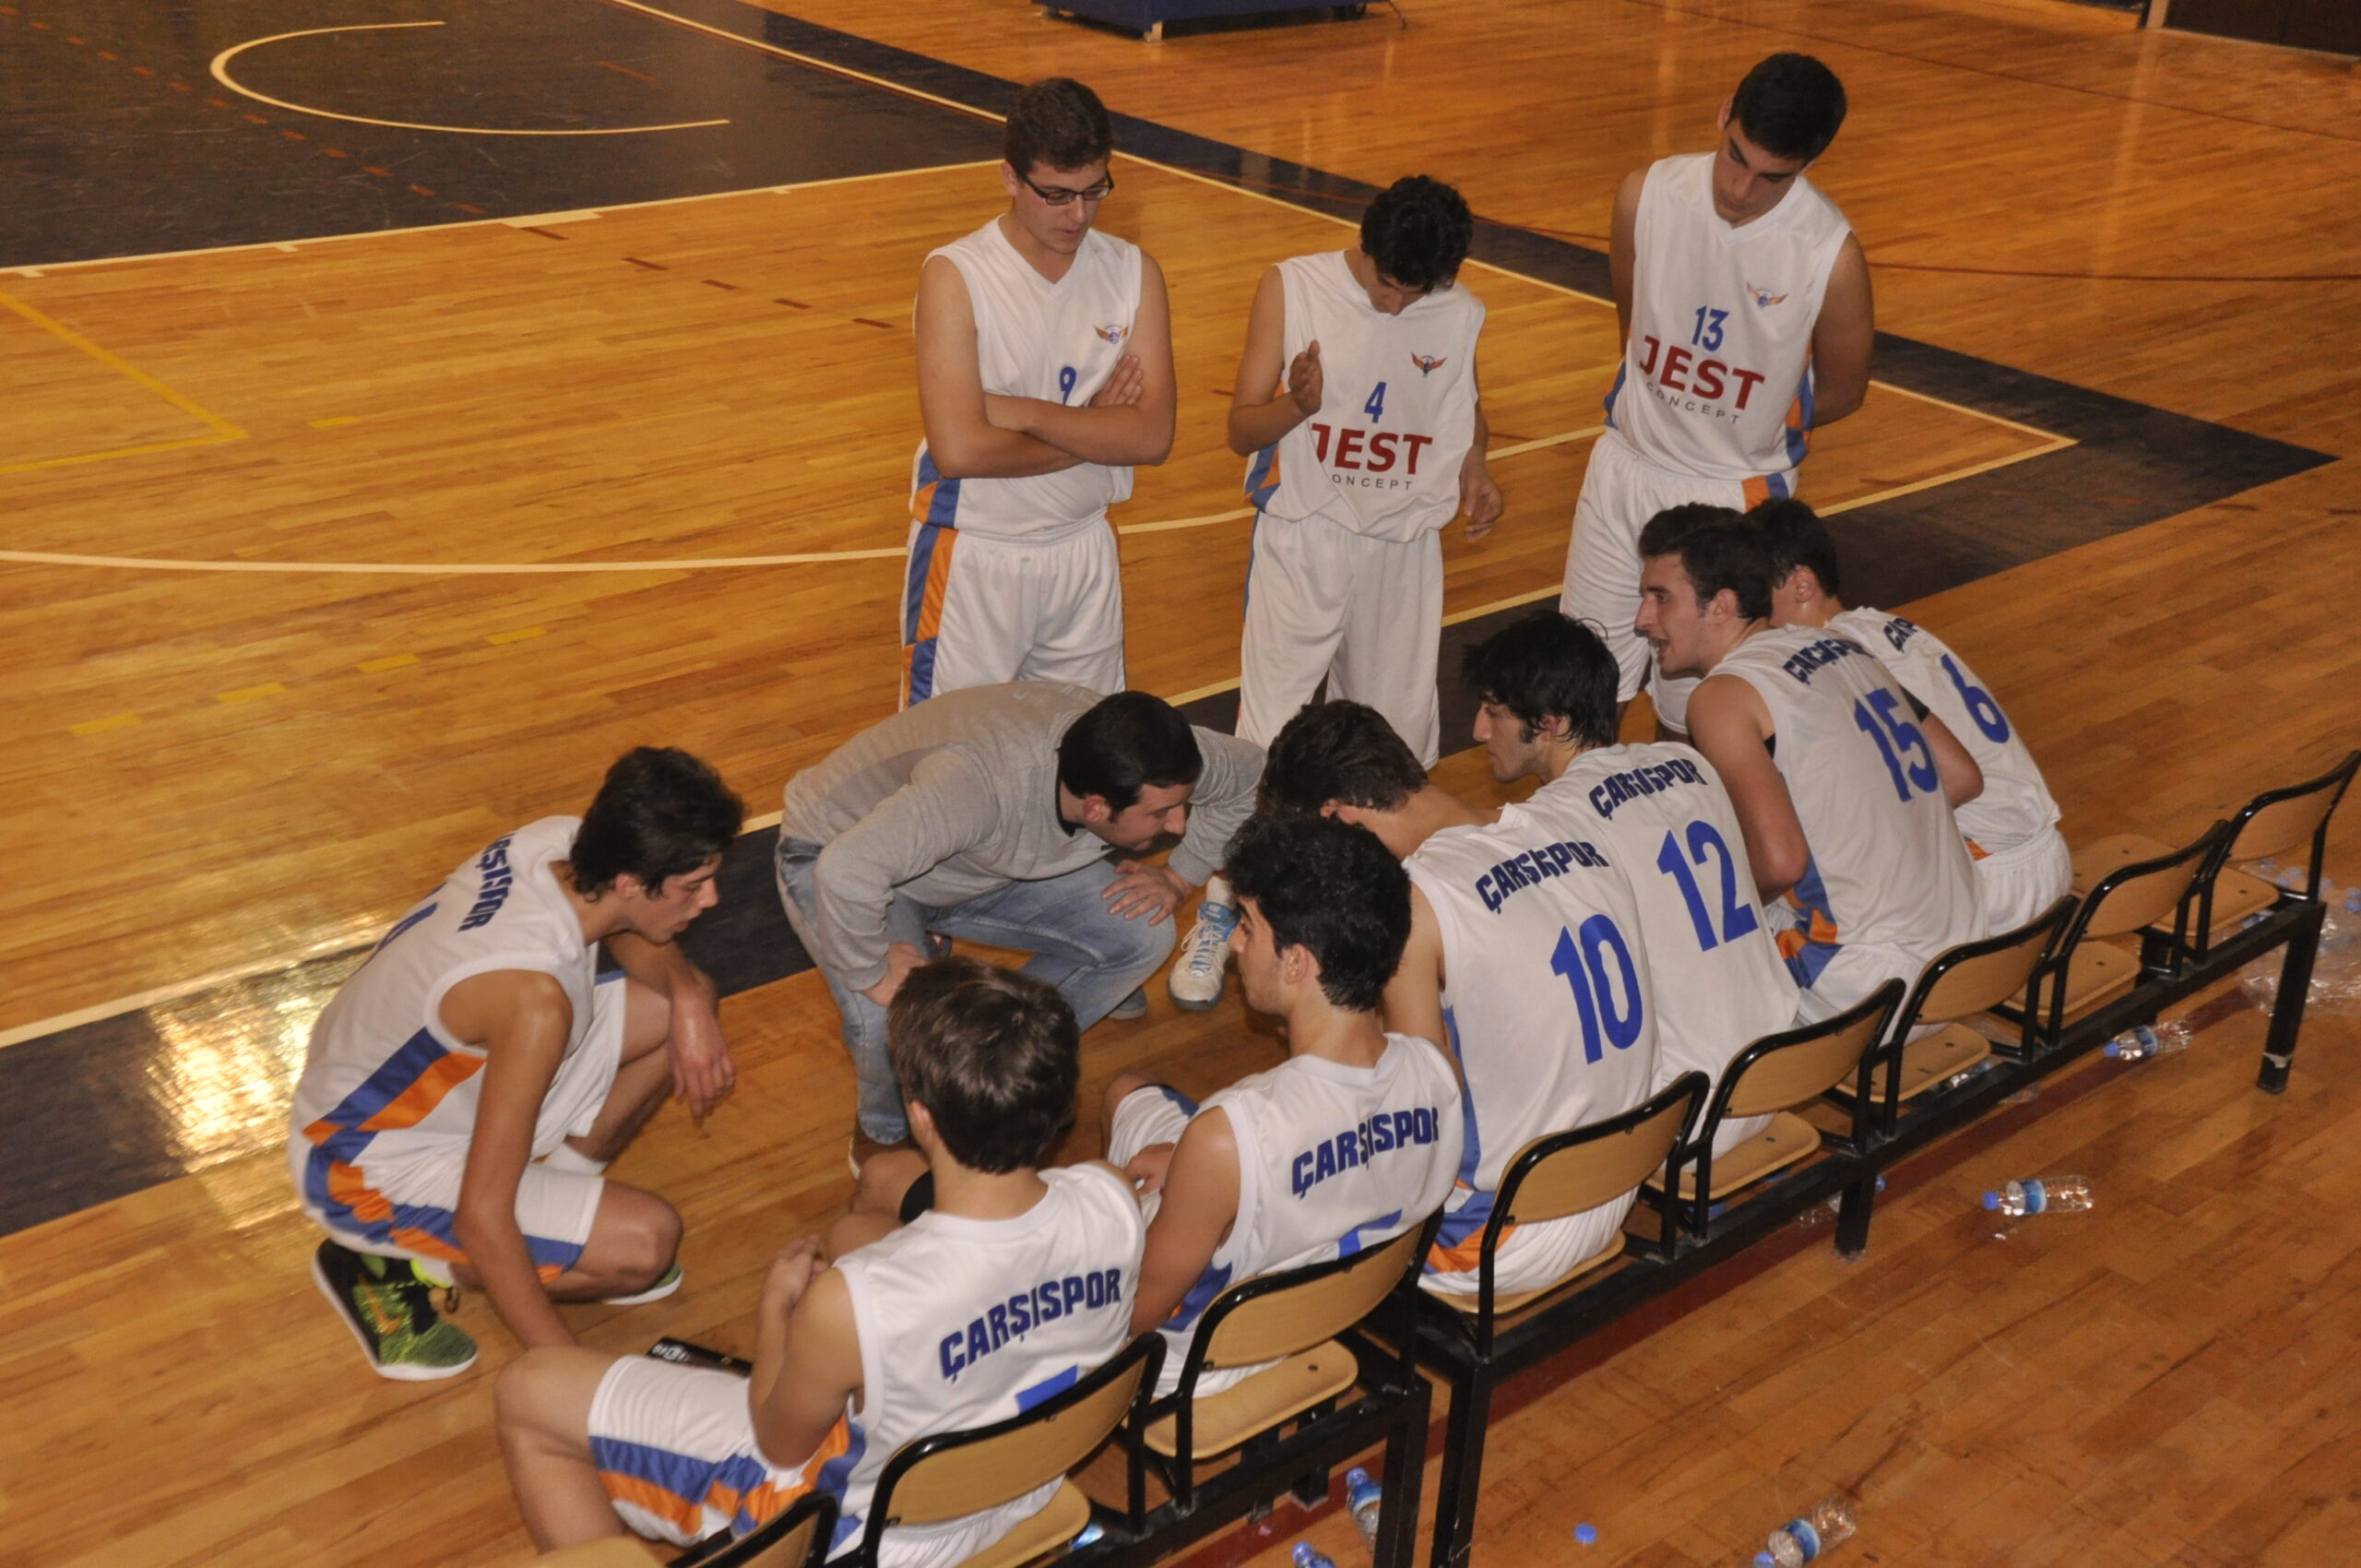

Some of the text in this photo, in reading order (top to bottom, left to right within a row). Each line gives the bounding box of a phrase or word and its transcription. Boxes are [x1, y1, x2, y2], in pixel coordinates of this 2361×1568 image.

[1691, 305, 1730, 352] 13
[1059, 365, 1077, 406] 9
[1364, 381, 1387, 423] 4
[1639, 335, 1765, 410] JEST
[1646, 381, 1739, 424] CONCEPT
[1331, 473, 1413, 491] ONCEPT
[1940, 653, 2010, 743] 6
[1854, 687, 1938, 802] 15
[1656, 820, 1759, 952] 12
[1549, 913, 1643, 1064] 10
[939, 1268, 1121, 1386] ÇARŞISPOR
